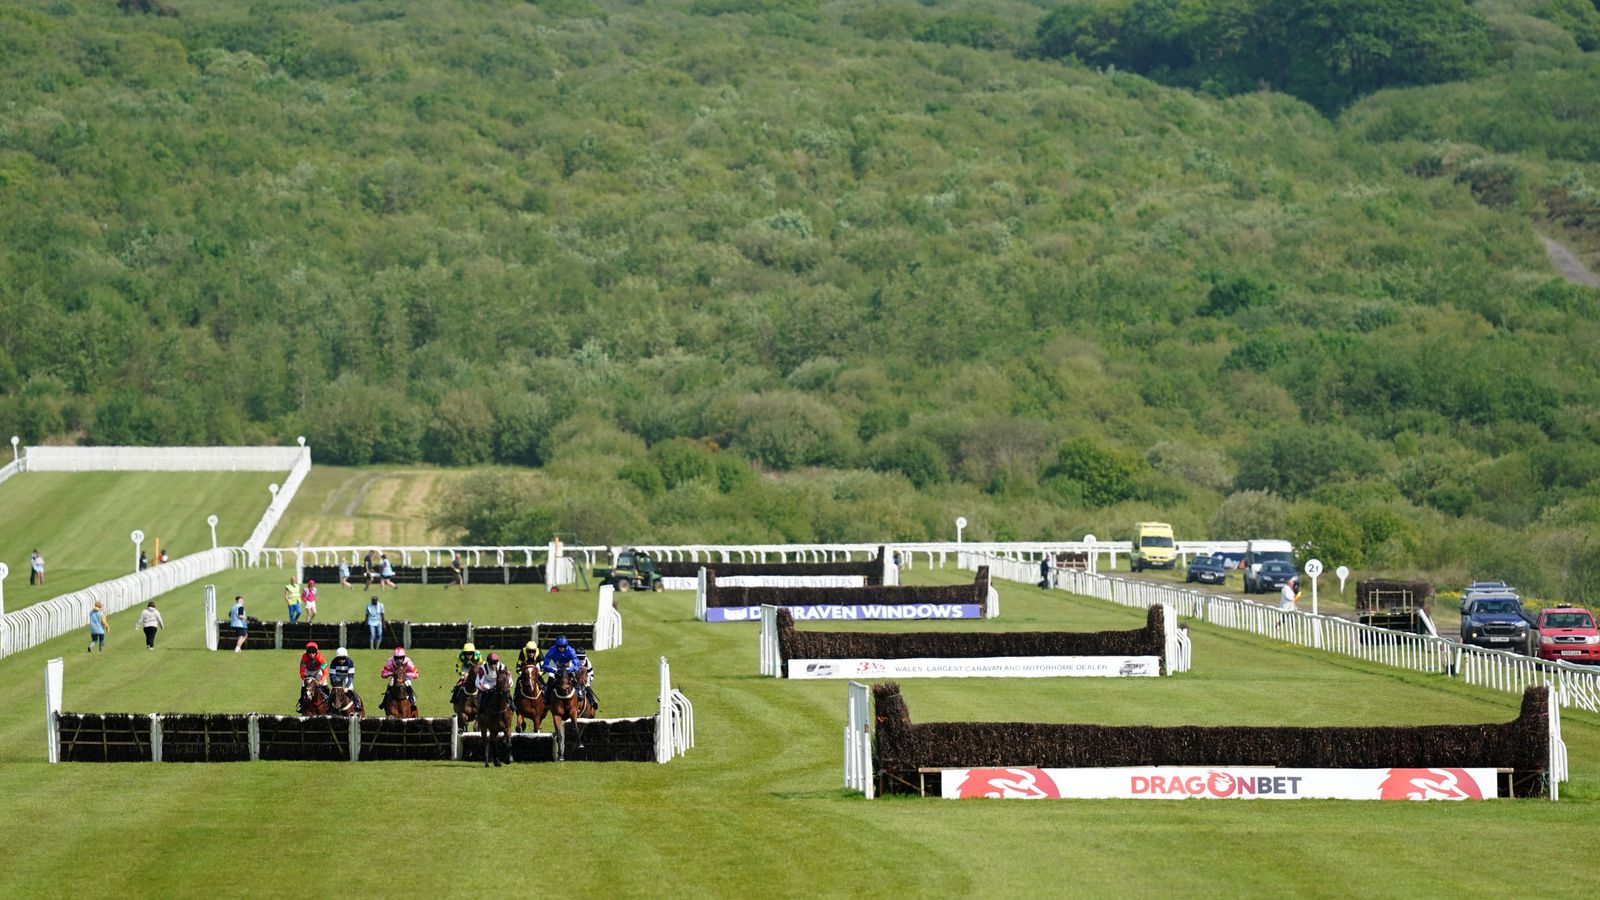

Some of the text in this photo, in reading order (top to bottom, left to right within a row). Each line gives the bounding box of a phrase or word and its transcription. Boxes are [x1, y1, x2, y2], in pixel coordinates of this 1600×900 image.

[749, 604, 963, 620] DRAVEN WINDOWS
[965, 664, 1003, 672] CARAVAN
[1131, 770, 1302, 798] DRAGONBET
